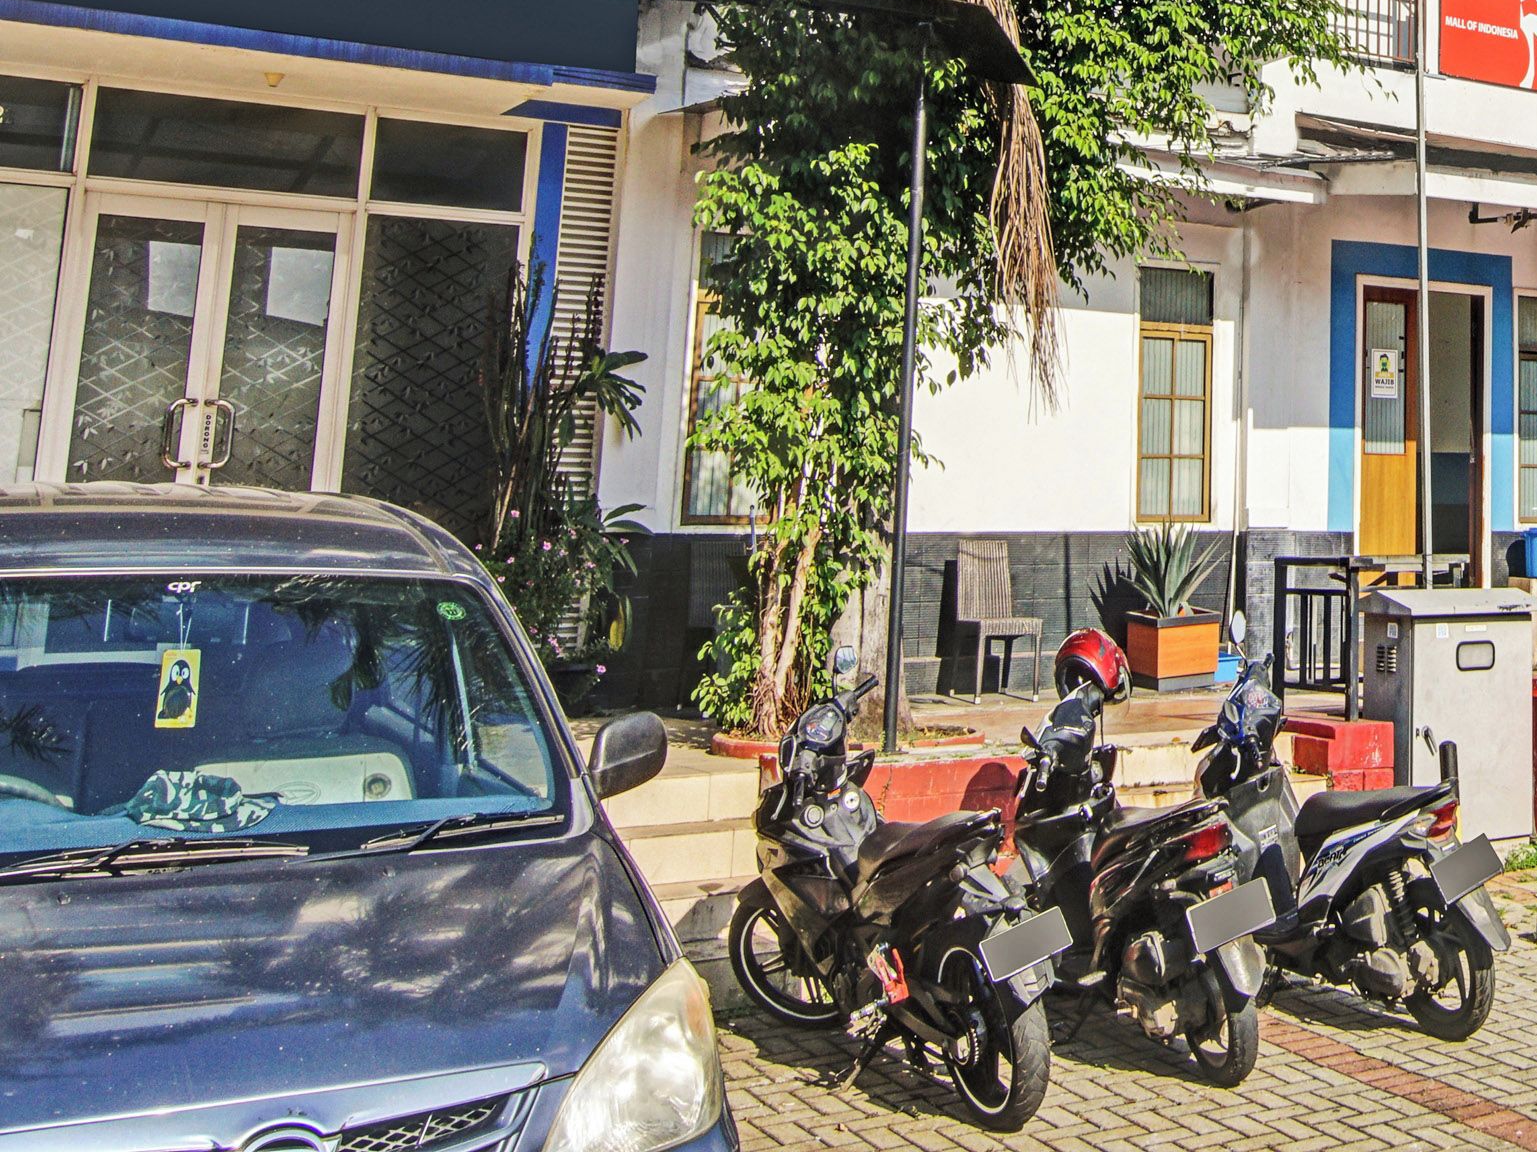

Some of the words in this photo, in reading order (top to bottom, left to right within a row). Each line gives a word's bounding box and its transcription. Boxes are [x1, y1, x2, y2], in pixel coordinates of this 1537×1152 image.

[1445, 15, 1466, 29] MALL
[1466, 19, 1478, 33] OF
[1478, 22, 1519, 40] INDONESIA
